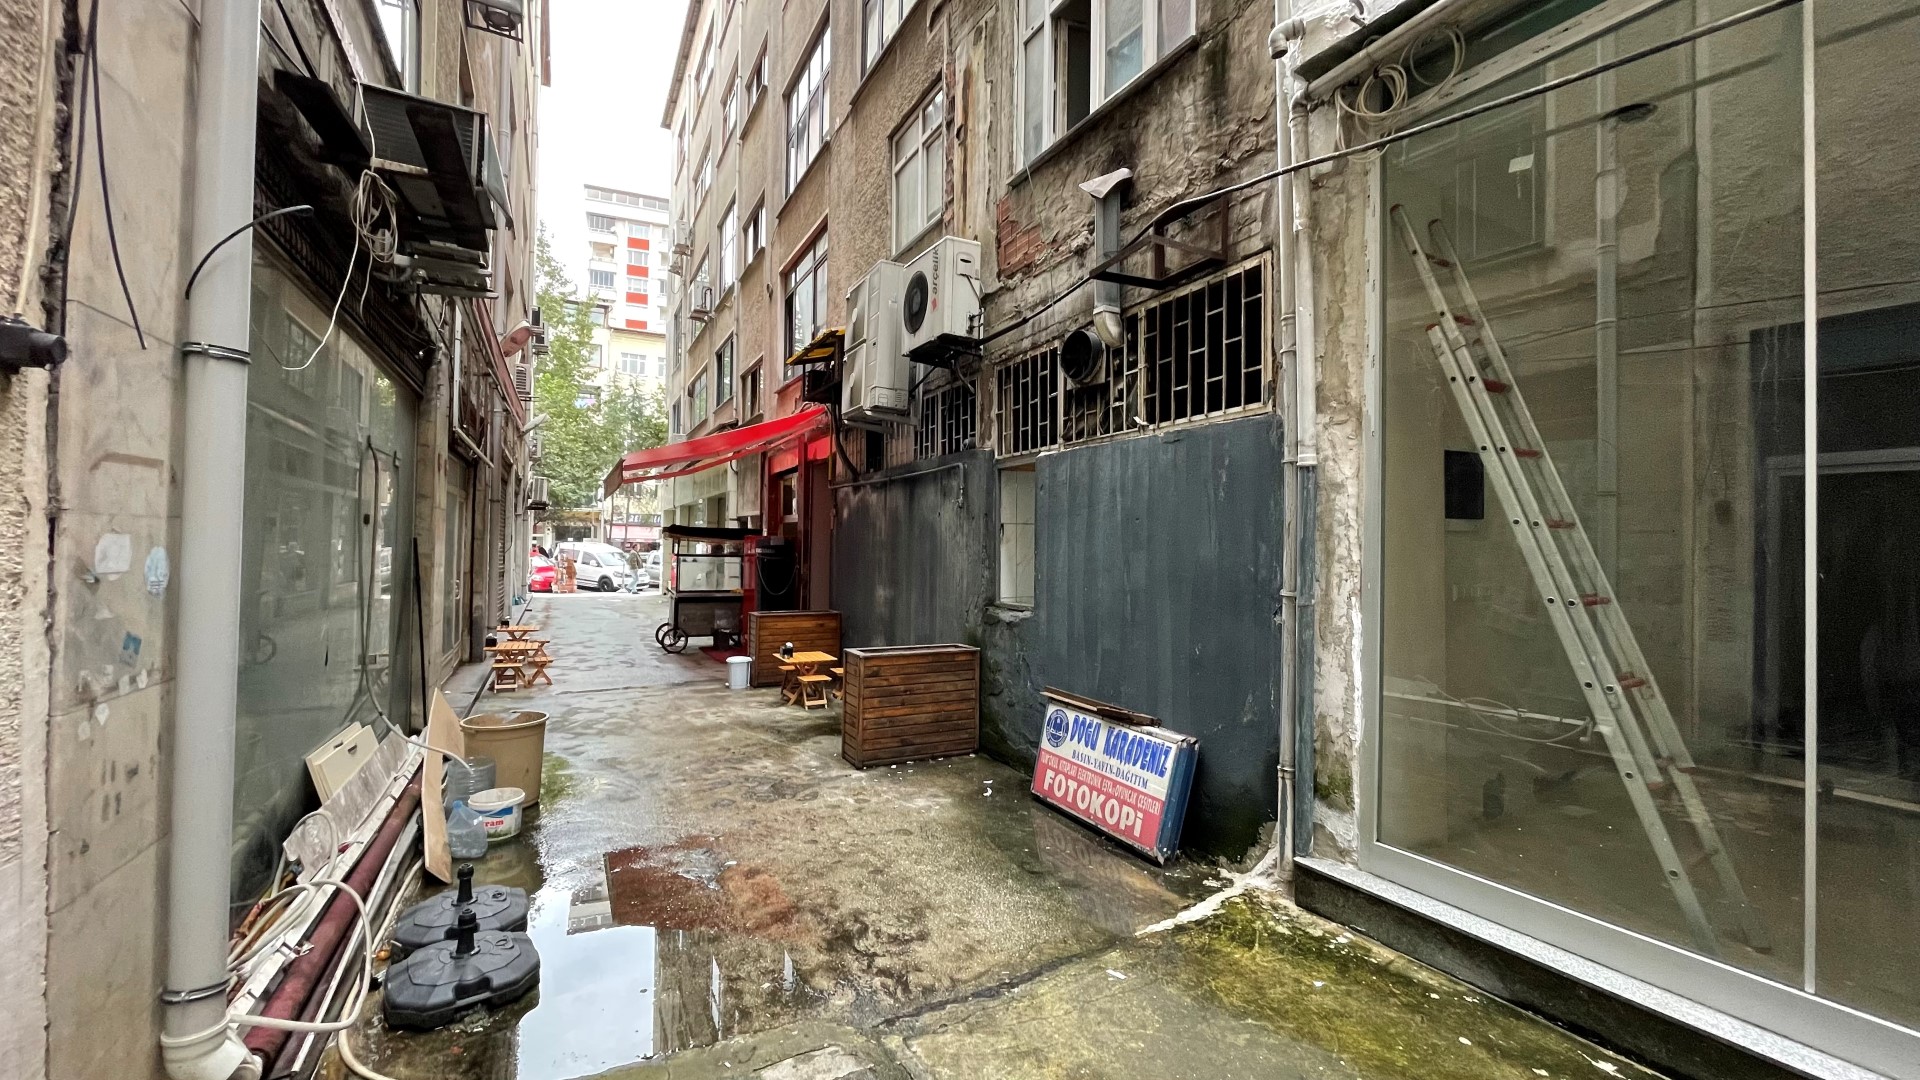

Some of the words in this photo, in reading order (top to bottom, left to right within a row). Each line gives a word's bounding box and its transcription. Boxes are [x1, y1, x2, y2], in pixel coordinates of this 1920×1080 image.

[932, 246, 940, 295] arçelik
[1070, 714, 1102, 750] DOĞU
[1103, 727, 1172, 778] KARADENİZ
[1043, 768, 1143, 838] FOTOKOPİ
